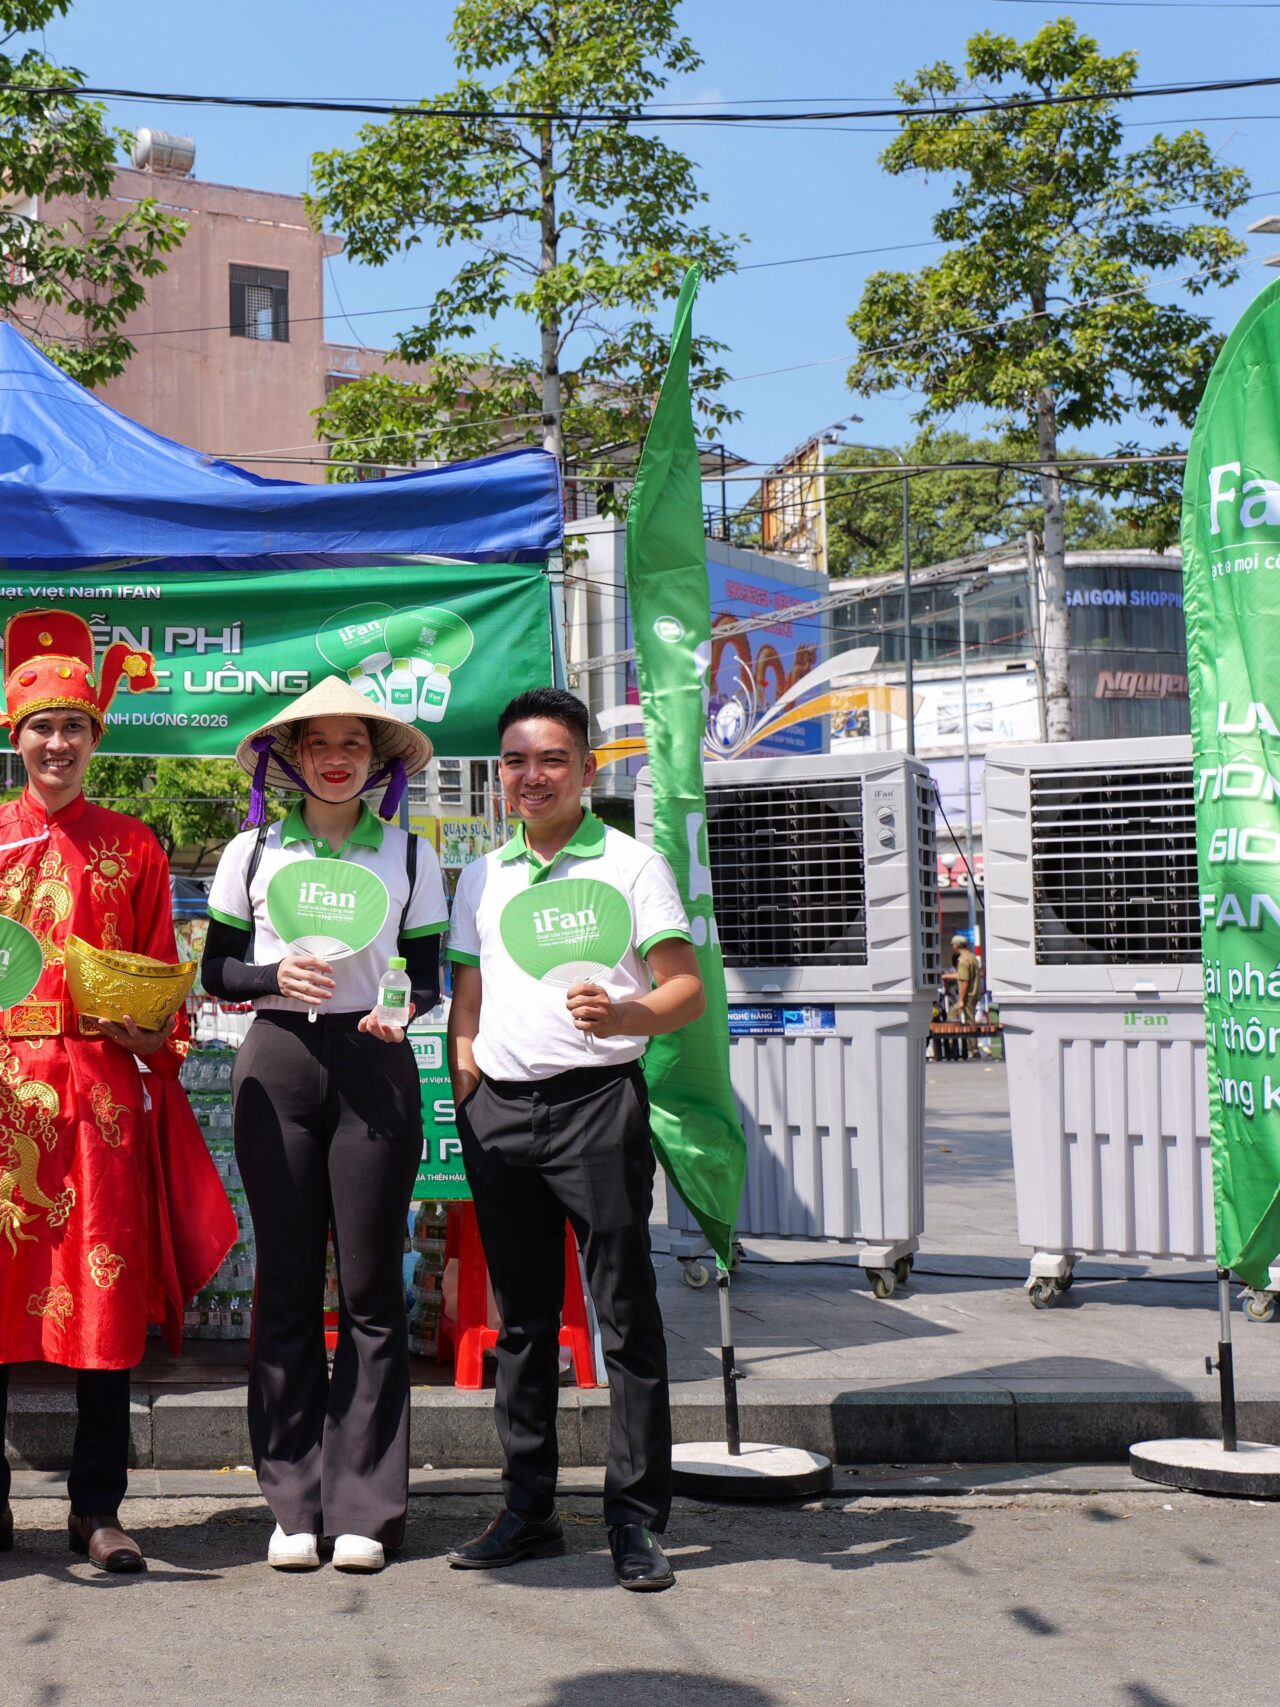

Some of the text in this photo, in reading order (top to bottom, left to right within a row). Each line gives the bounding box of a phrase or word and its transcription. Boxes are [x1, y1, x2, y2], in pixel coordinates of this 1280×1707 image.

[70, 586, 112, 599] Nam
[117, 586, 161, 599] IFAN
[165, 621, 241, 653] PHÍ
[184, 661, 309, 693] UỐNG
[132, 711, 188, 726] DƯƠNG
[190, 714, 229, 727] 2026
[299, 882, 355, 908] iFan
[533, 907, 597, 933] iFan
[1124, 1008, 1169, 1025] iFan
